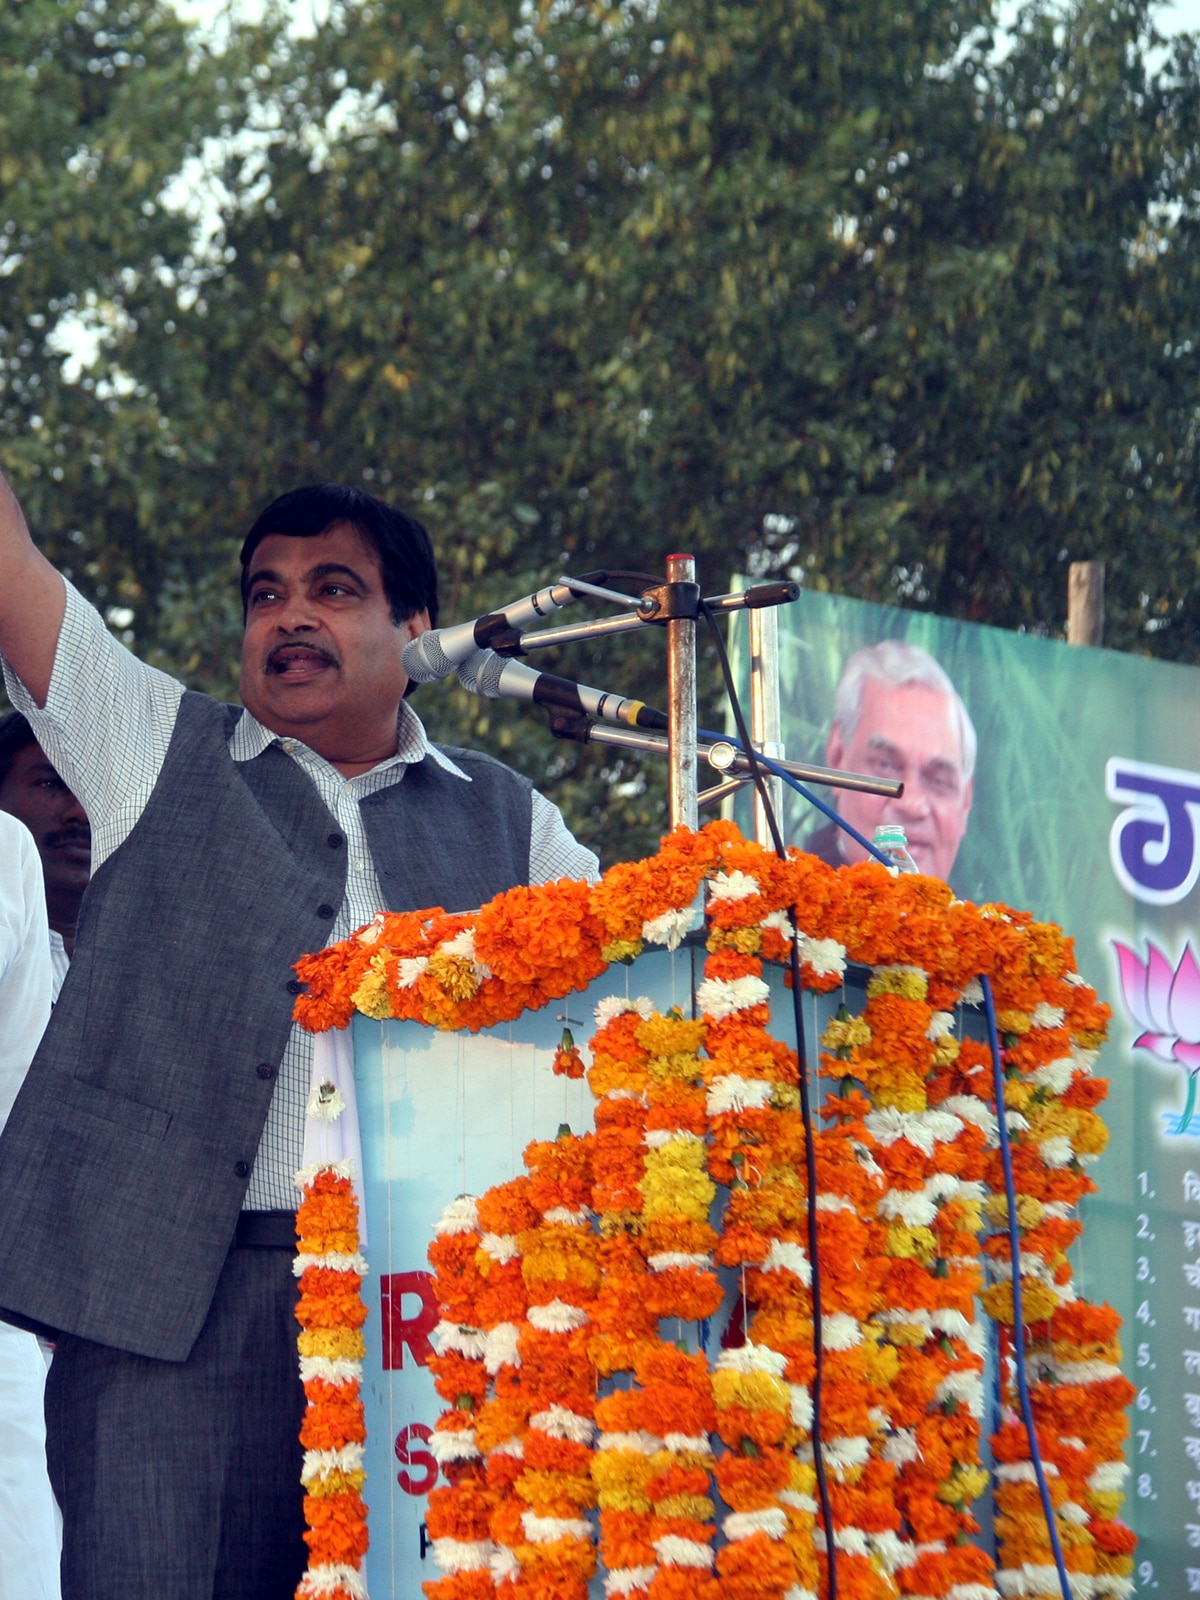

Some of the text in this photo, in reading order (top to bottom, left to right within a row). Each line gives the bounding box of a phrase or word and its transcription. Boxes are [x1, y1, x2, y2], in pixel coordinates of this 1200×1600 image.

[1136, 1170, 1156, 1199] 1.
[1136, 1213, 1156, 1241] 2.
[1136, 1256, 1156, 1285] 3.
[380, 1270, 441, 1370] R
[1135, 1300, 1157, 1327] 4.
[1136, 1342, 1157, 1371] 5.
[1136, 1386, 1157, 1414] 6.
[1136, 1429, 1157, 1457] 7.
[1137, 1472, 1158, 1500] 8.
[1138, 1561, 1159, 1588] 9.
